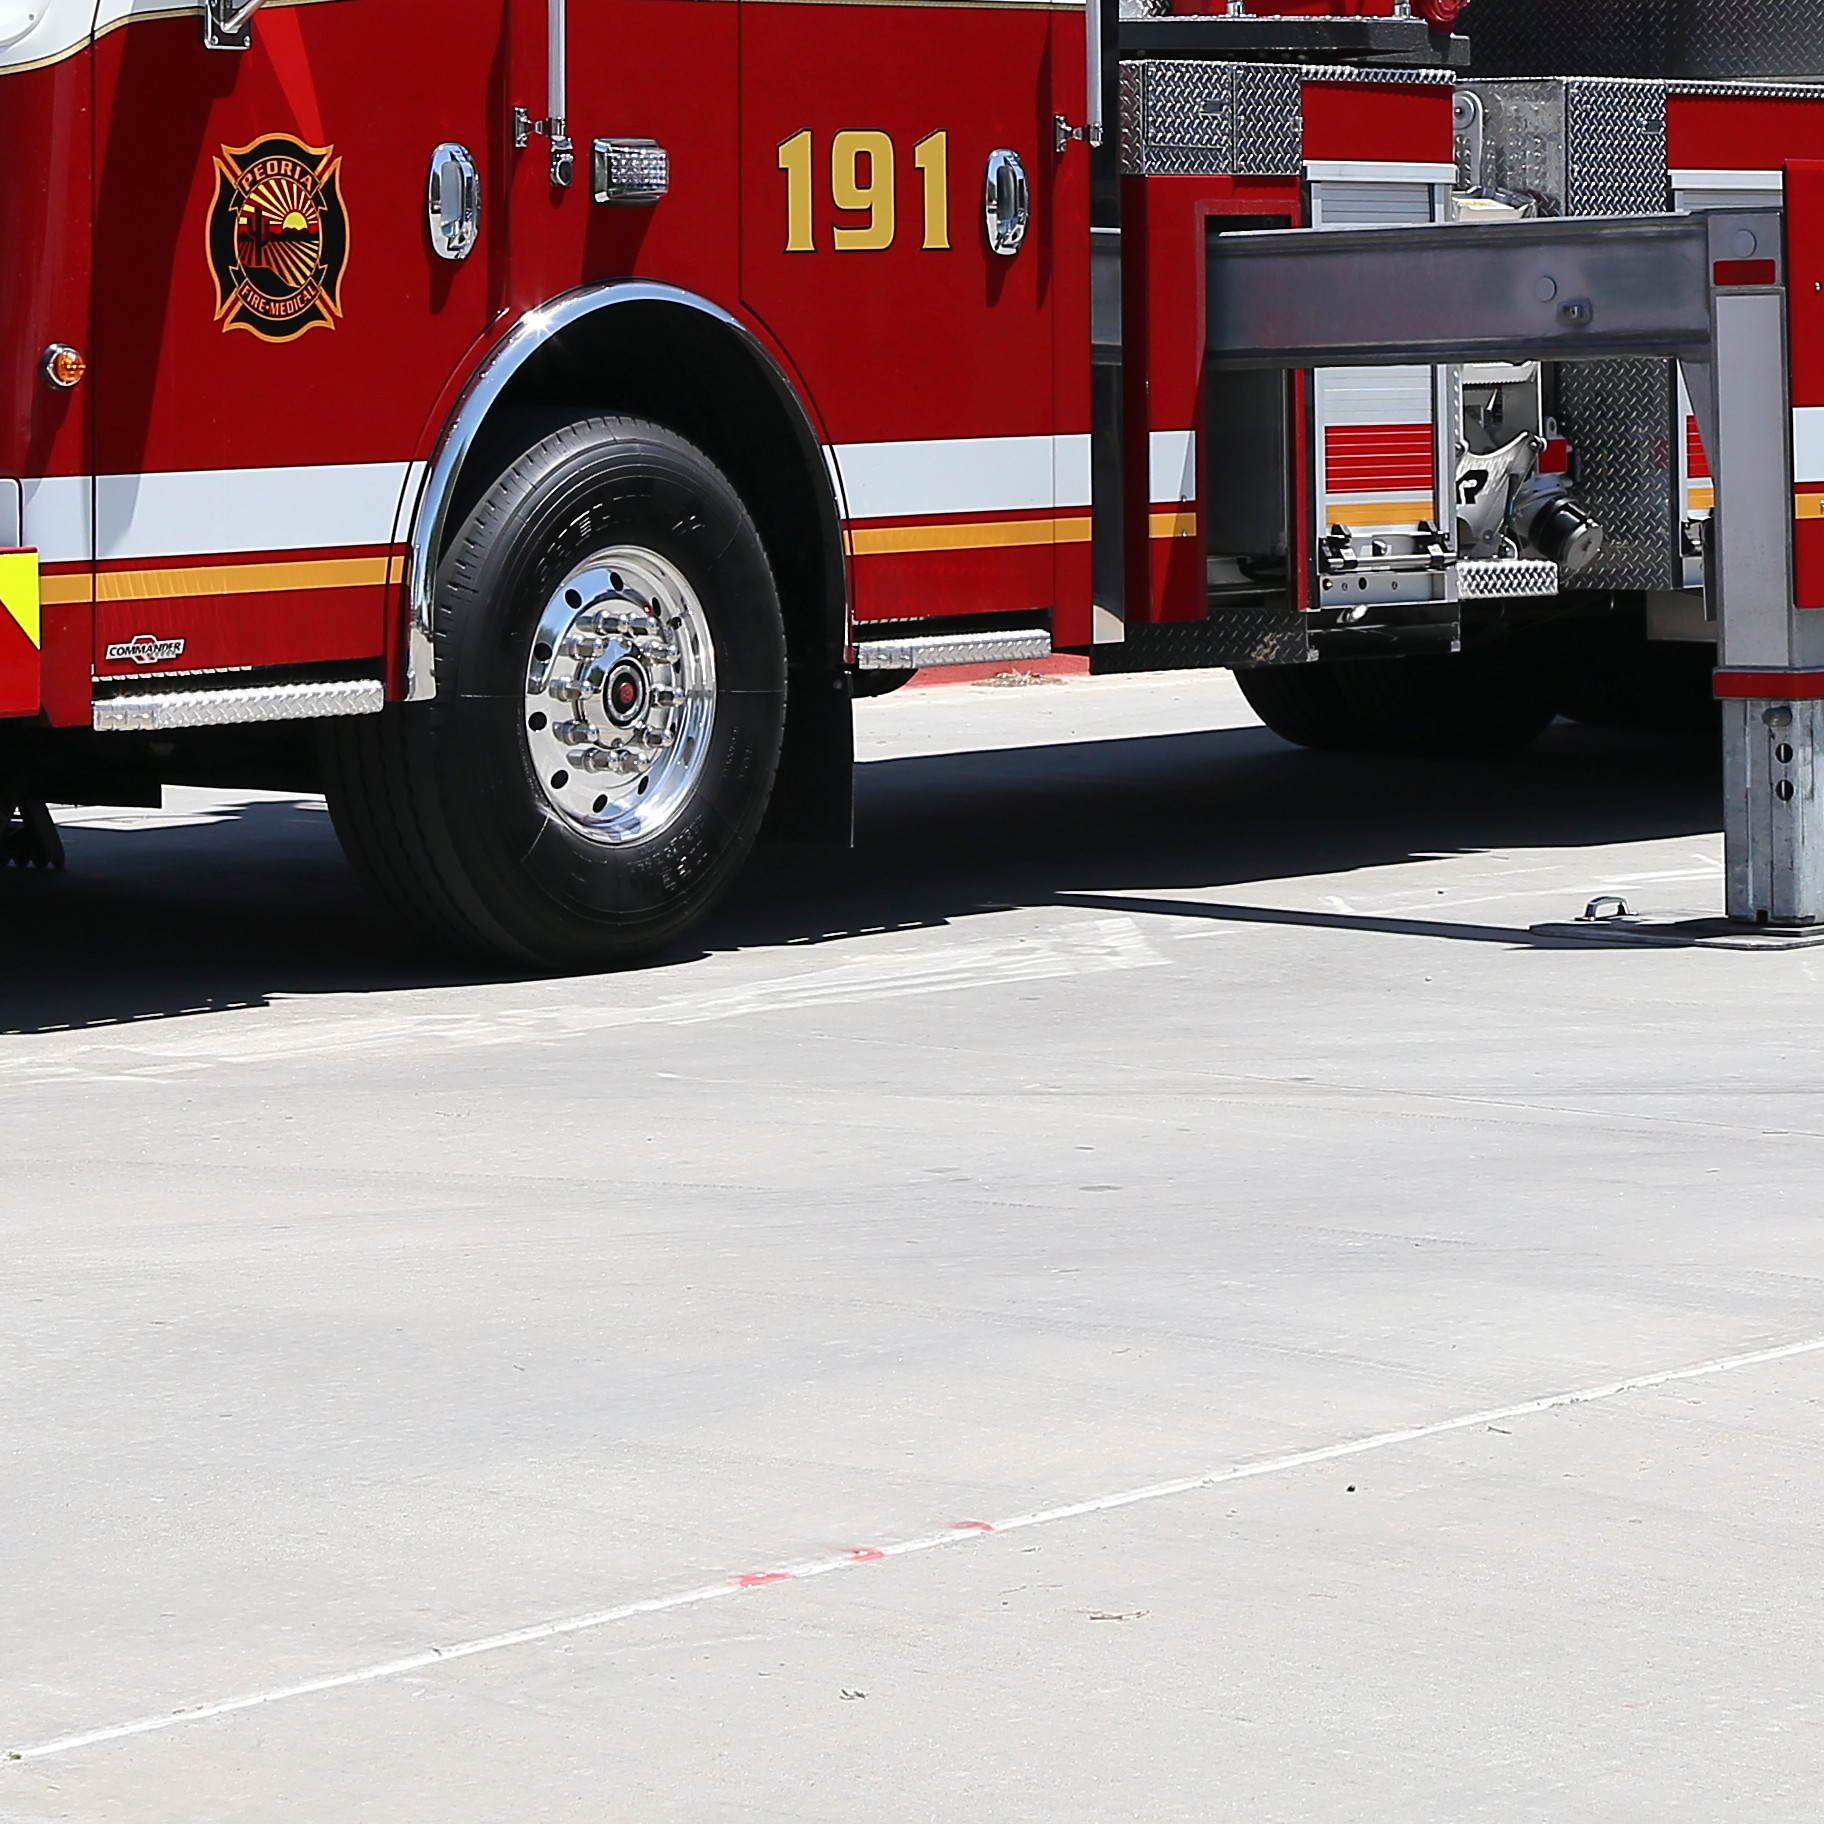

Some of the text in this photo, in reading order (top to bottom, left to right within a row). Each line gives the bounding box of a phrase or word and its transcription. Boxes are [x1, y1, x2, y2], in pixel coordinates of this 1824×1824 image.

[240, 160, 313, 192] PEORIA
[776, 127, 953, 253] 191
[108, 641, 182, 657] COMMANDER
